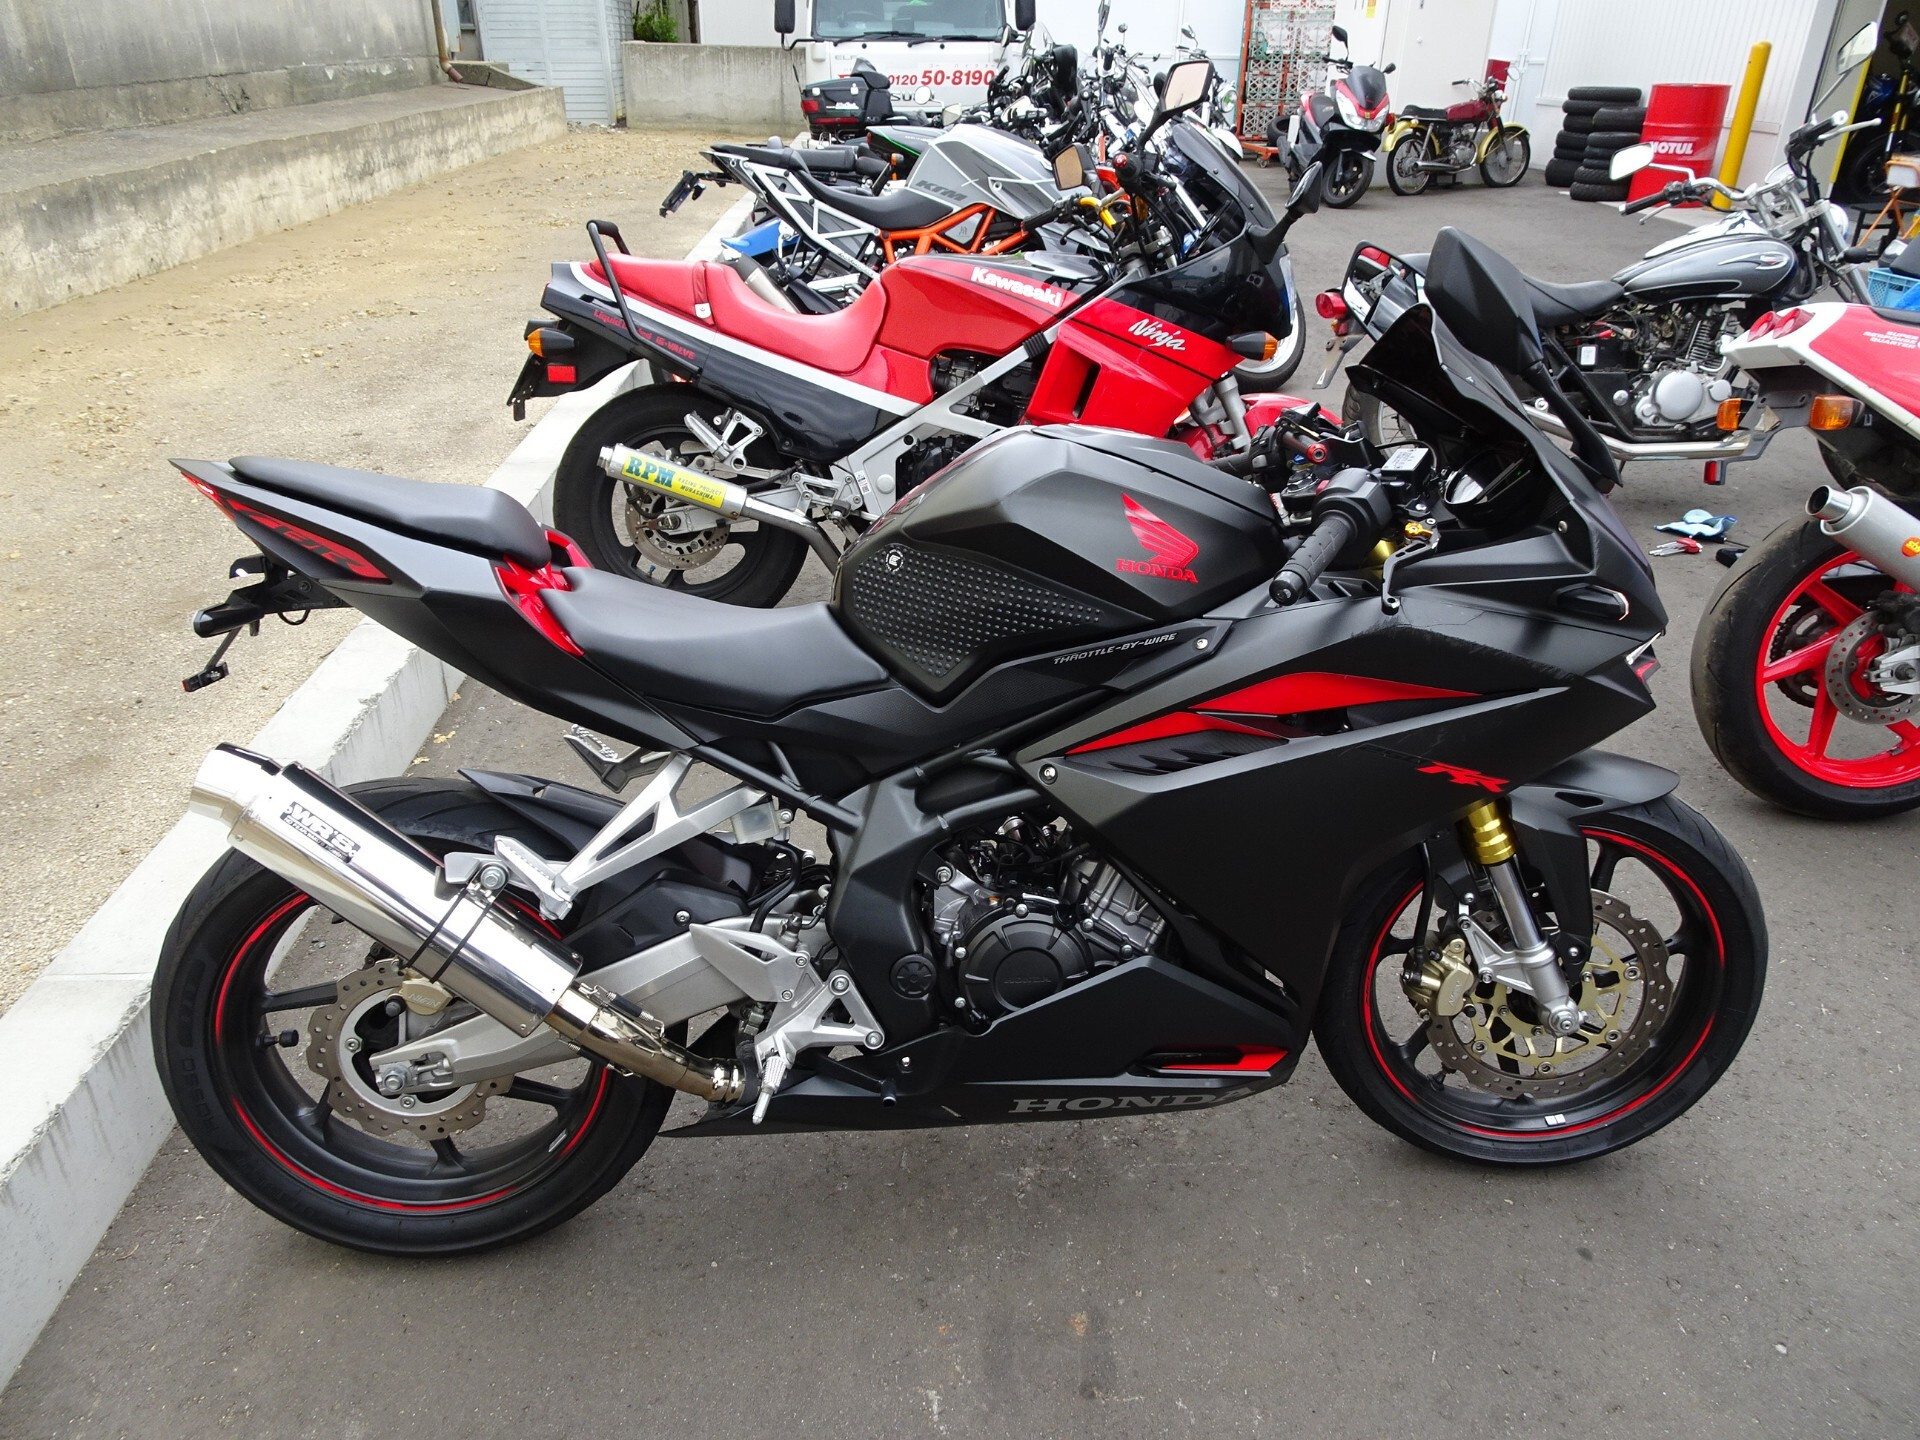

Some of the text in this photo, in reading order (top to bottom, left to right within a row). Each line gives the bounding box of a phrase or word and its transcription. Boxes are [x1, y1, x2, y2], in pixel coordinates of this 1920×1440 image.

[888, 74, 918, 86] 0120
[915, 179, 969, 202] KTM
[970, 266, 1063, 308] Kawasaki
[1128, 318, 1187, 351] Ninja
[626, 456, 676, 488] RPM
[1116, 558, 1198, 584] HONDA
[1053, 632, 1178, 666] THROTTLE-BY-WIRE
[1008, 1087, 1254, 1114] HONDA
